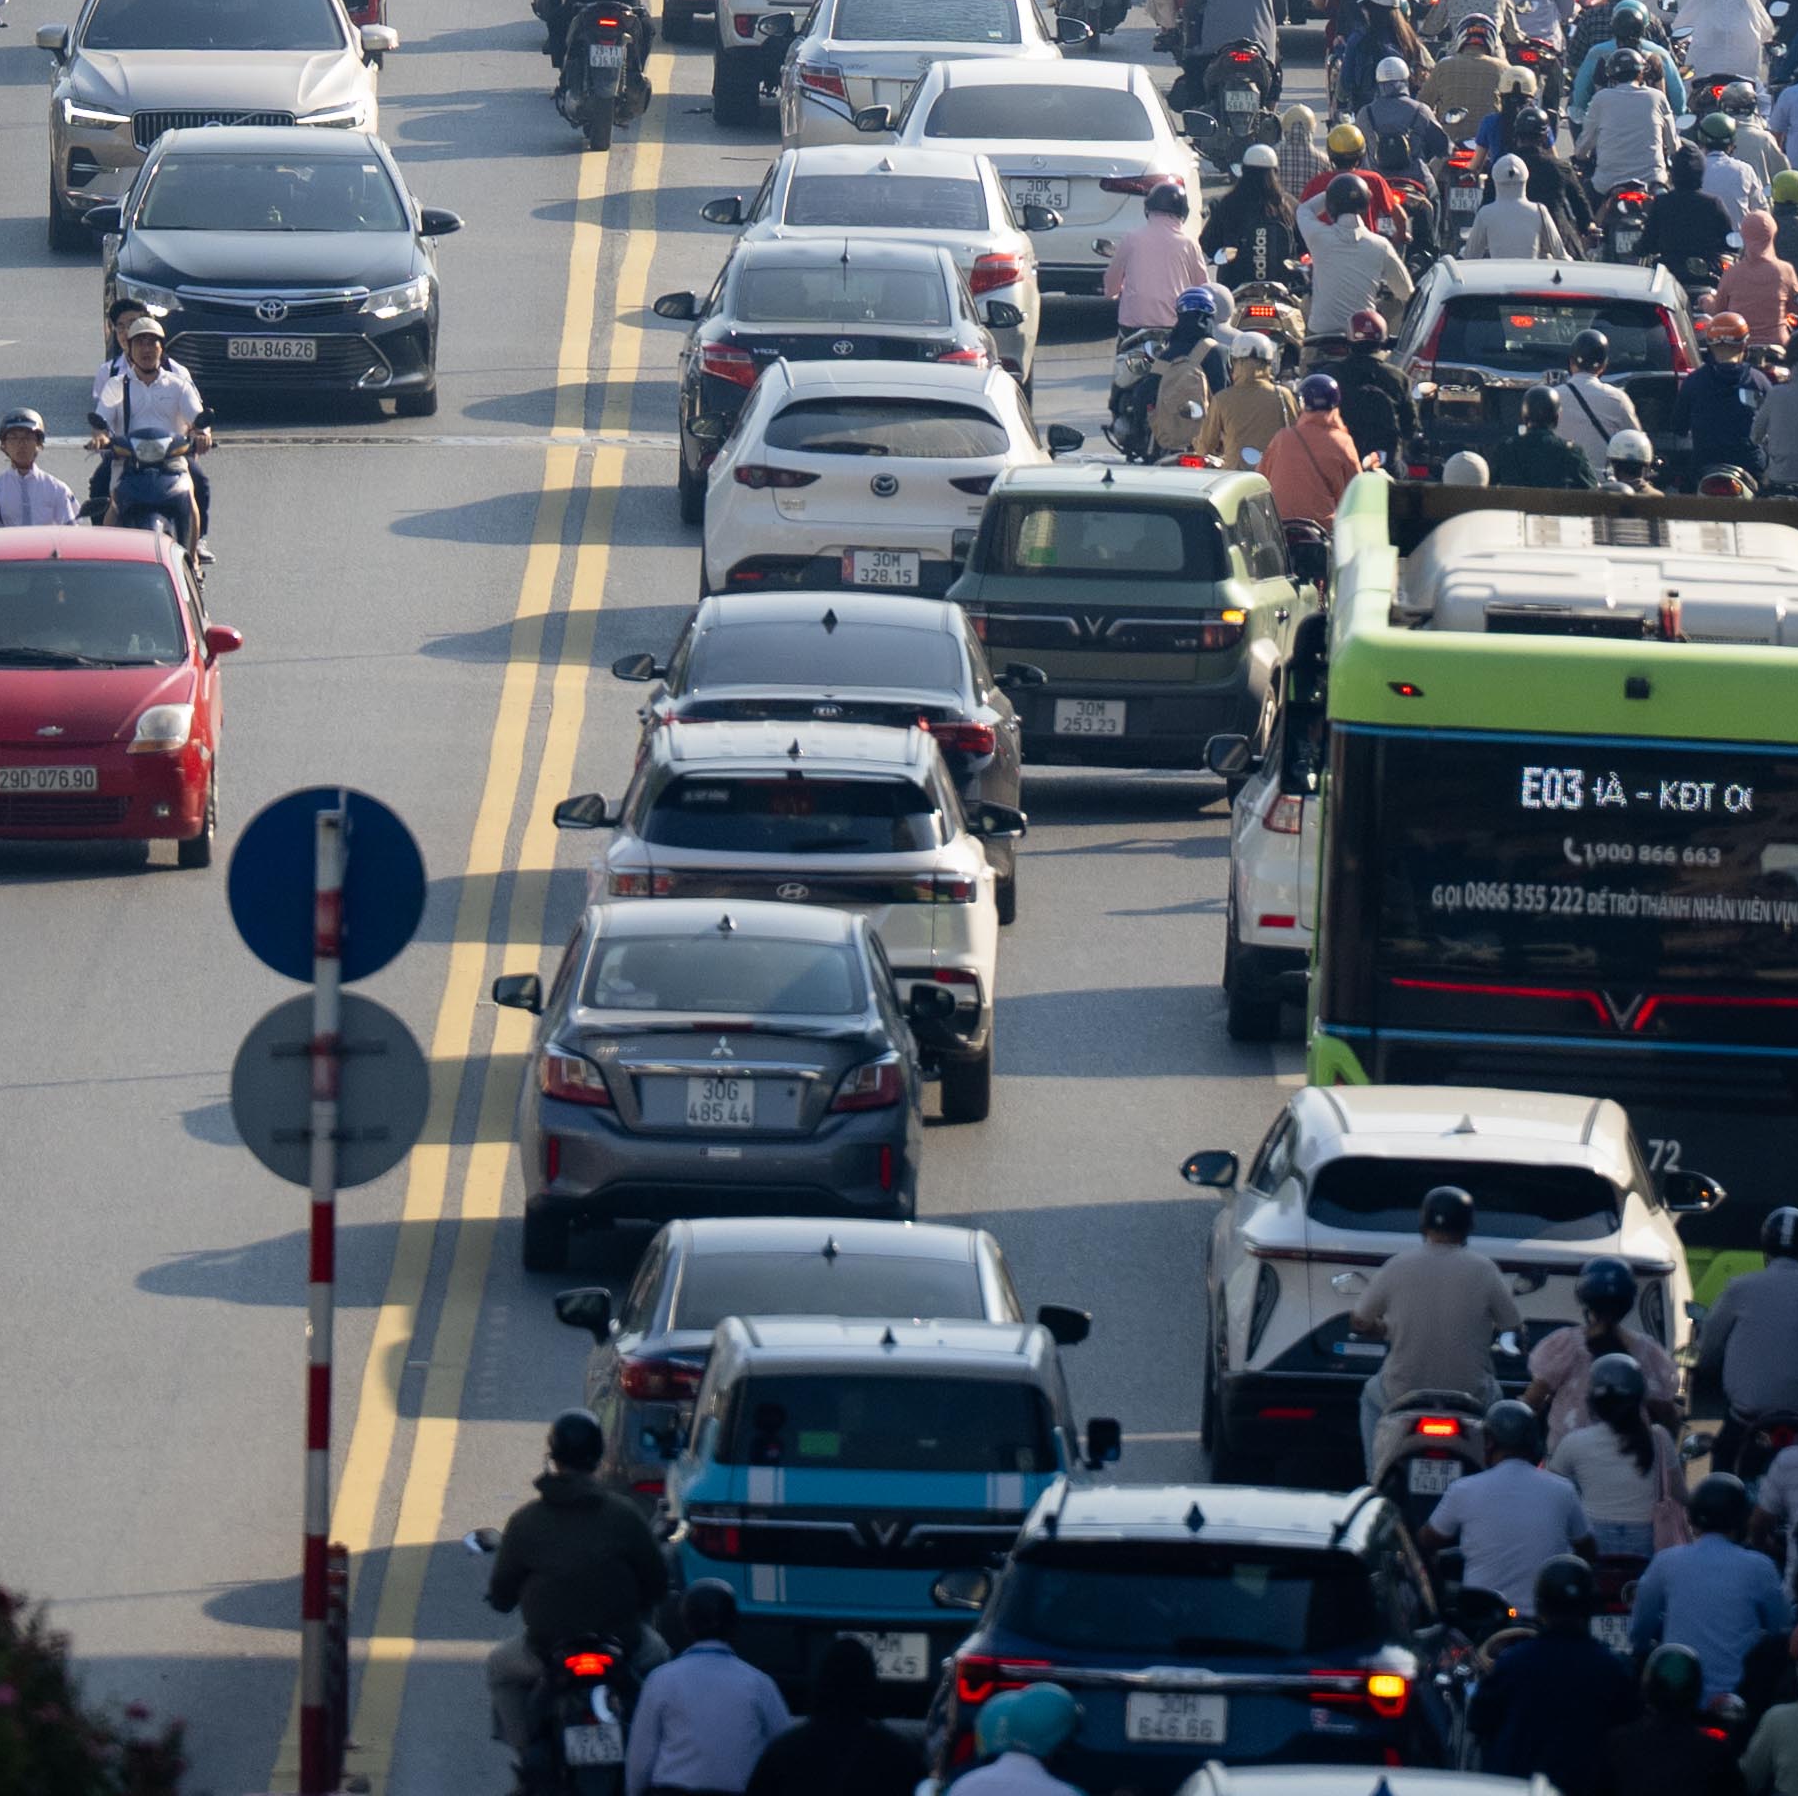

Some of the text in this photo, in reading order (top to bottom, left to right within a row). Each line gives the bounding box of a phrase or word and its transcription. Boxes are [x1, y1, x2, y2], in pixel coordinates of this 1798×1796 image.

[1027, 179, 1052, 192] 30K
[1015, 193, 1062, 207] 566.45
[1252, 227, 1267, 281] adidas
[231, 340, 313, 358] 30A-846.26
[860, 568, 912, 584] 328.15
[1062, 717, 1116, 733] 253.23
[0, 769, 95, 790] 29D-076.90
[1521, 766, 1585, 810] E03
[1659, 779, 1717, 812] KĐT
[1583, 842, 1721, 867] 1900 866 663
[1464, 881, 1510, 910] 0866
[1512, 883, 1547, 912] 355
[1550, 885, 1584, 915] 222
[702, 1080, 739, 1101] 30G
[688, 1102, 750, 1123] 485.44
